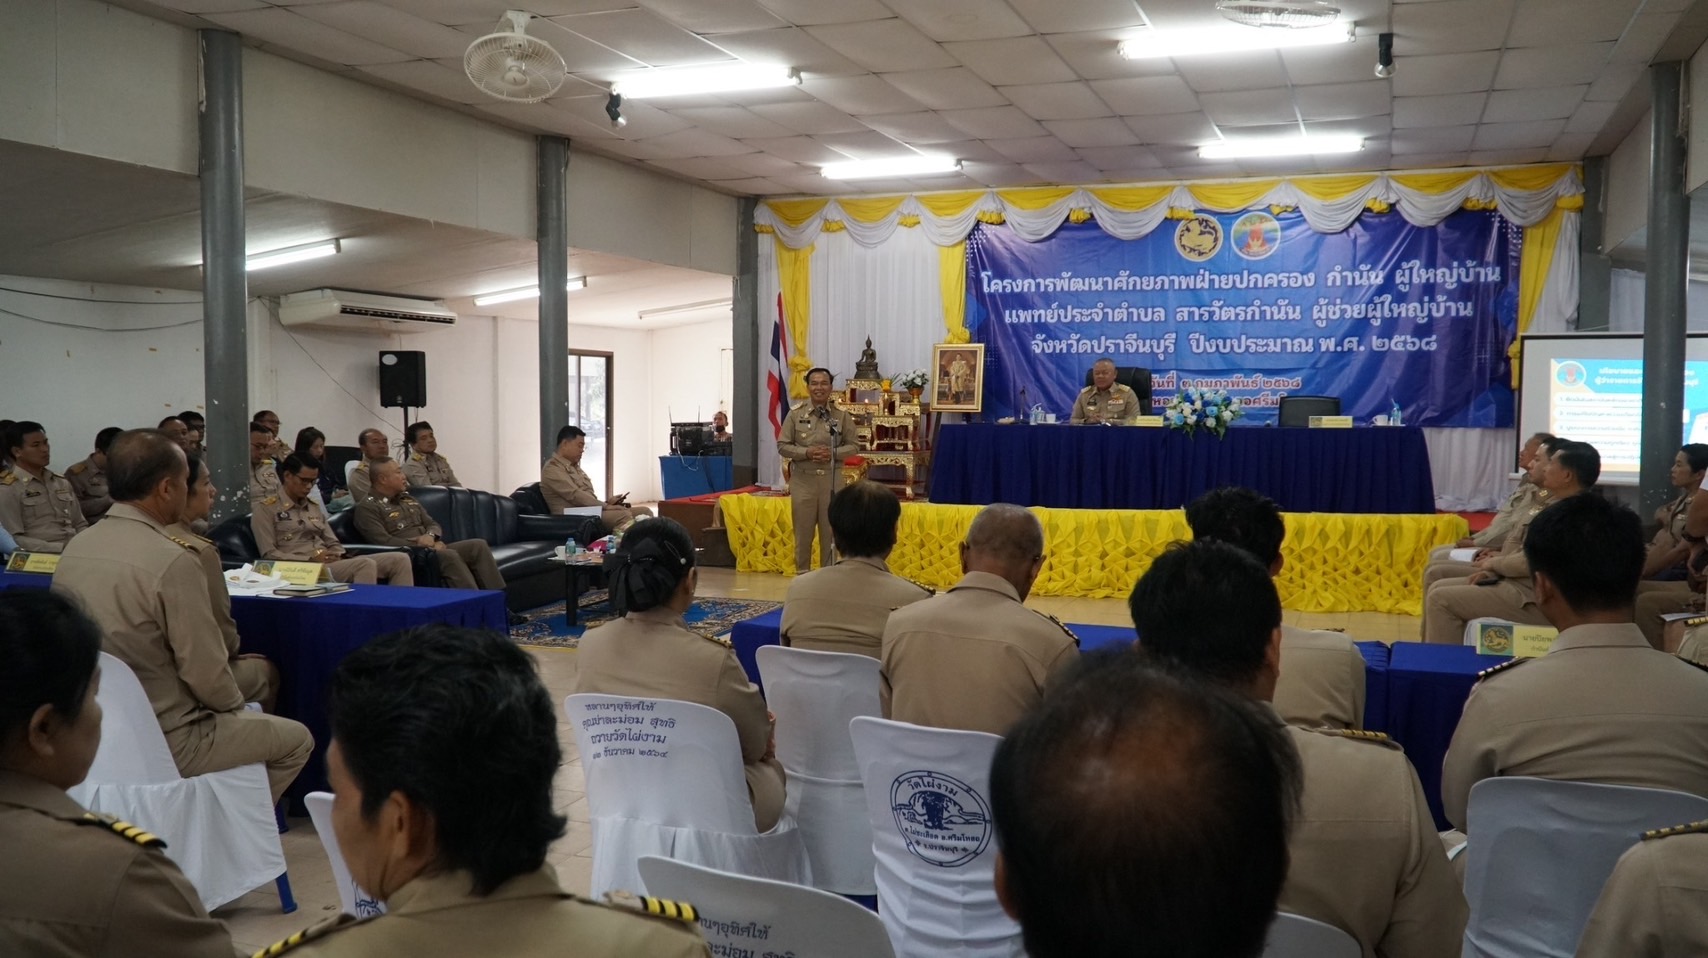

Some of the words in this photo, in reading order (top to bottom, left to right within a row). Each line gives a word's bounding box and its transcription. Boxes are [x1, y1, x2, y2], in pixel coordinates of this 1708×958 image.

[981, 268, 1316, 293] โครงการพัฒนาศักยภาพฝ่ายปกครอง
[1326, 264, 1384, 287] กำนัน
[1395, 259, 1502, 293] ผู้ใหญ่บ้าน
[1005, 301, 1166, 323] แพทย์ประจำตำบล
[1175, 298, 1301, 322] สารวัตรกำนัน
[1312, 294, 1474, 328] ผู้ช่วยผู้ใหญ่บ้าน
[1031, 332, 1177, 361] จังหวัดปราจีนบุรี
[1188, 332, 1314, 354] ปีงบประมาณ
[1319, 335, 1365, 352] พ.ศ.
[1372, 334, 1437, 351] ๒๕๖๘
[1195, 373, 1262, 389] กมภาพันธ์
[1262, 377, 1302, 389] ๒๕๖๘
[907, 777, 959, 797] วัดไผ่งาม
